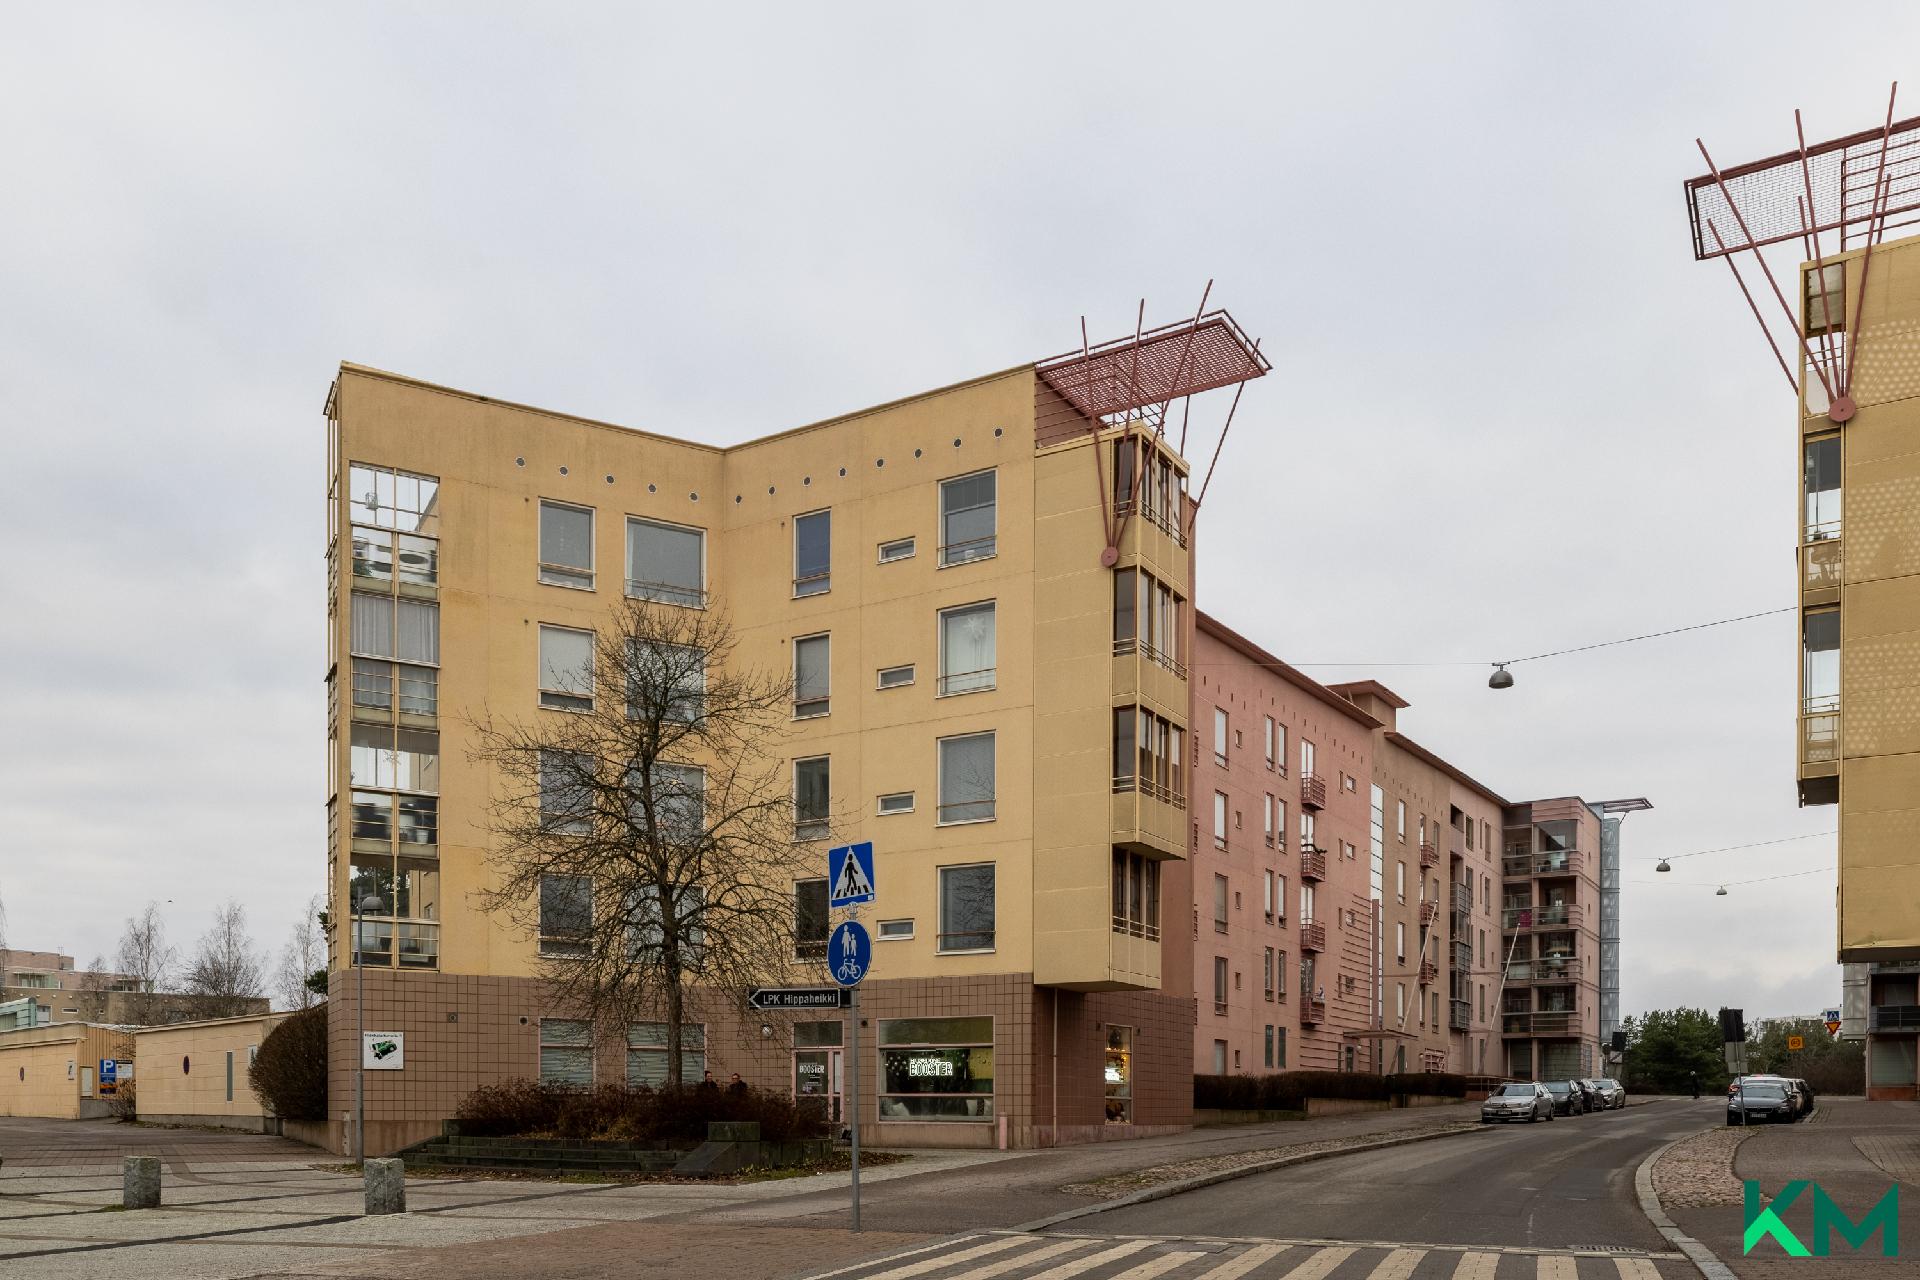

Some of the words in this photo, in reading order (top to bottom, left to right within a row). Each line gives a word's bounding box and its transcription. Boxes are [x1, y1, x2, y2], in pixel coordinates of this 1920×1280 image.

[763, 994, 780, 1004] LPK
[784, 993, 836, 1005] Hippaheikki
[104, 1060, 114, 1072] P
[799, 1065, 825, 1073] BOOSTER
[909, 1061, 953, 1076] BOOSTER
